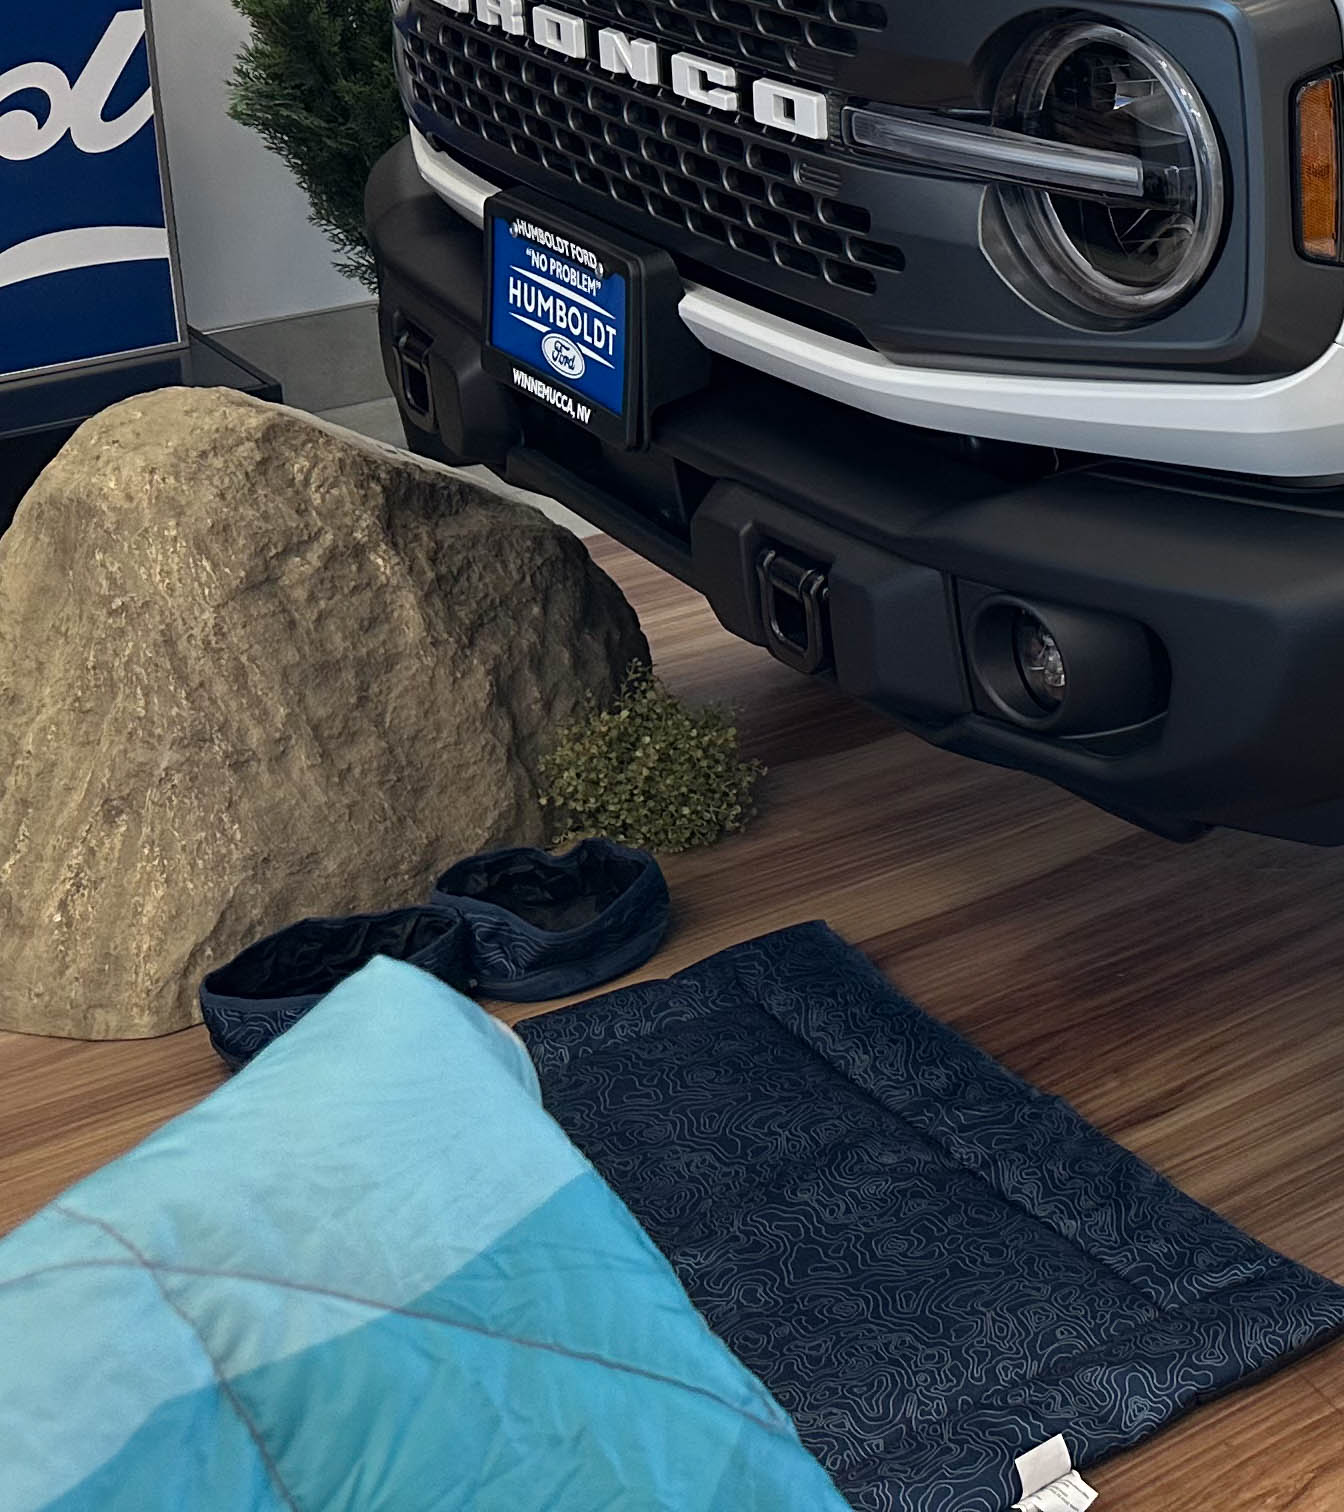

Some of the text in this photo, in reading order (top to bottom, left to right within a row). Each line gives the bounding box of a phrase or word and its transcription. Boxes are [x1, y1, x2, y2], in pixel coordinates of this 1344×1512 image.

[516, 218, 597, 268] HUMBOLDT FORD
[509, 276, 617, 356] HUMBOLDT
[551, 340, 576, 371] Ford
[512, 367, 592, 425] WINNEMUCCA, NV
